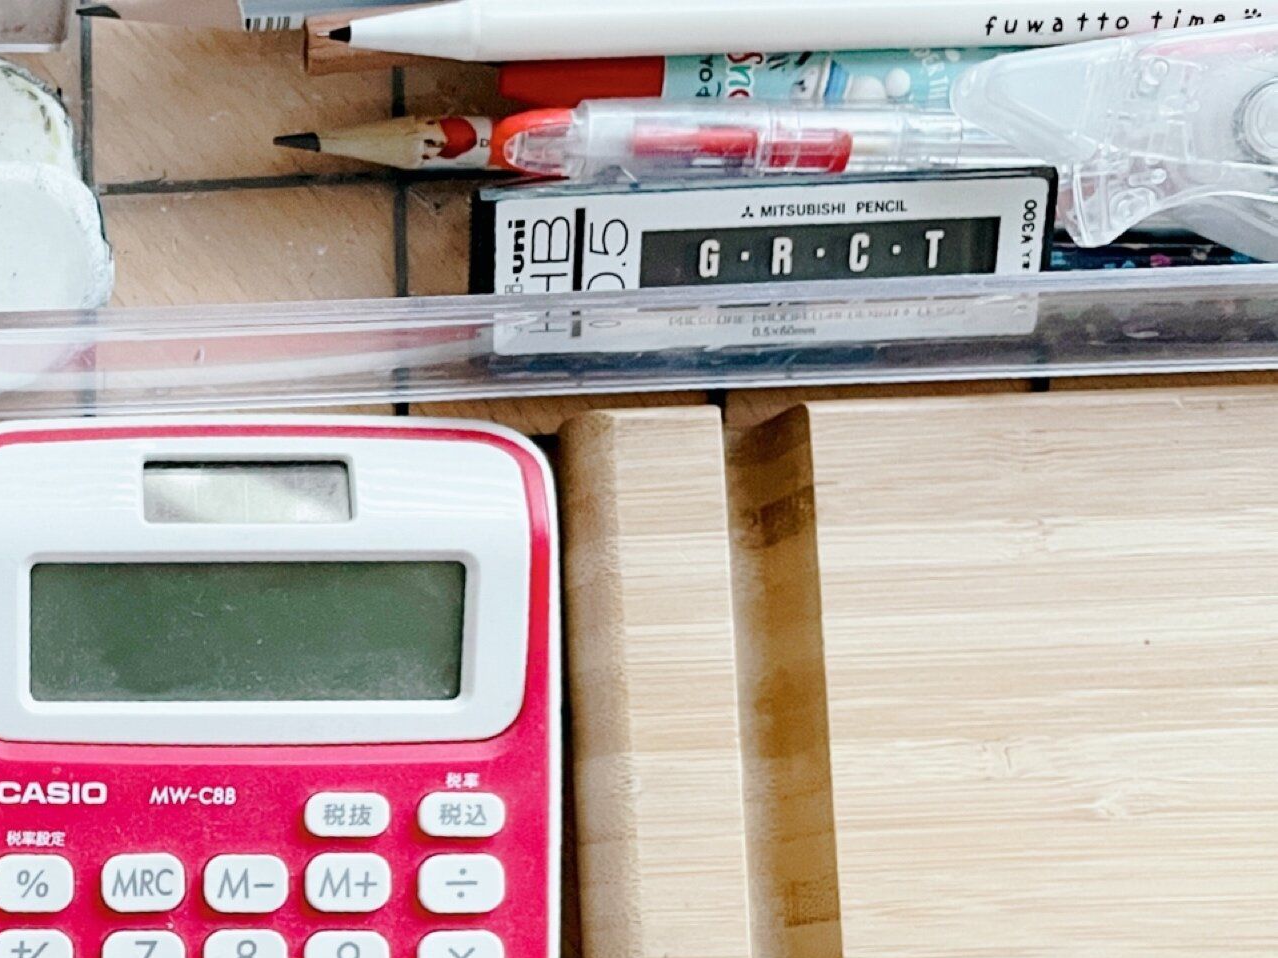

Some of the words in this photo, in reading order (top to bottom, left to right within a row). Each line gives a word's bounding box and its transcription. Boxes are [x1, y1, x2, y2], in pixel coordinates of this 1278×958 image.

[984, 12, 1130, 36] fuwatto
[1150, 9, 1226, 29] time
[760, 201, 846, 217] MITSUBISHI
[856, 199, 908, 214] PENCIL
[149, 786, 237, 805] MW-C8B
[323, 803, 373, 827] 税抜
[438, 803, 487, 827] 税込
[6, 830, 66, 846] 税率設定
[16, 867, 49, 898] %
[112, 867, 174, 898] MRC
[319, 866, 378, 896] M+
